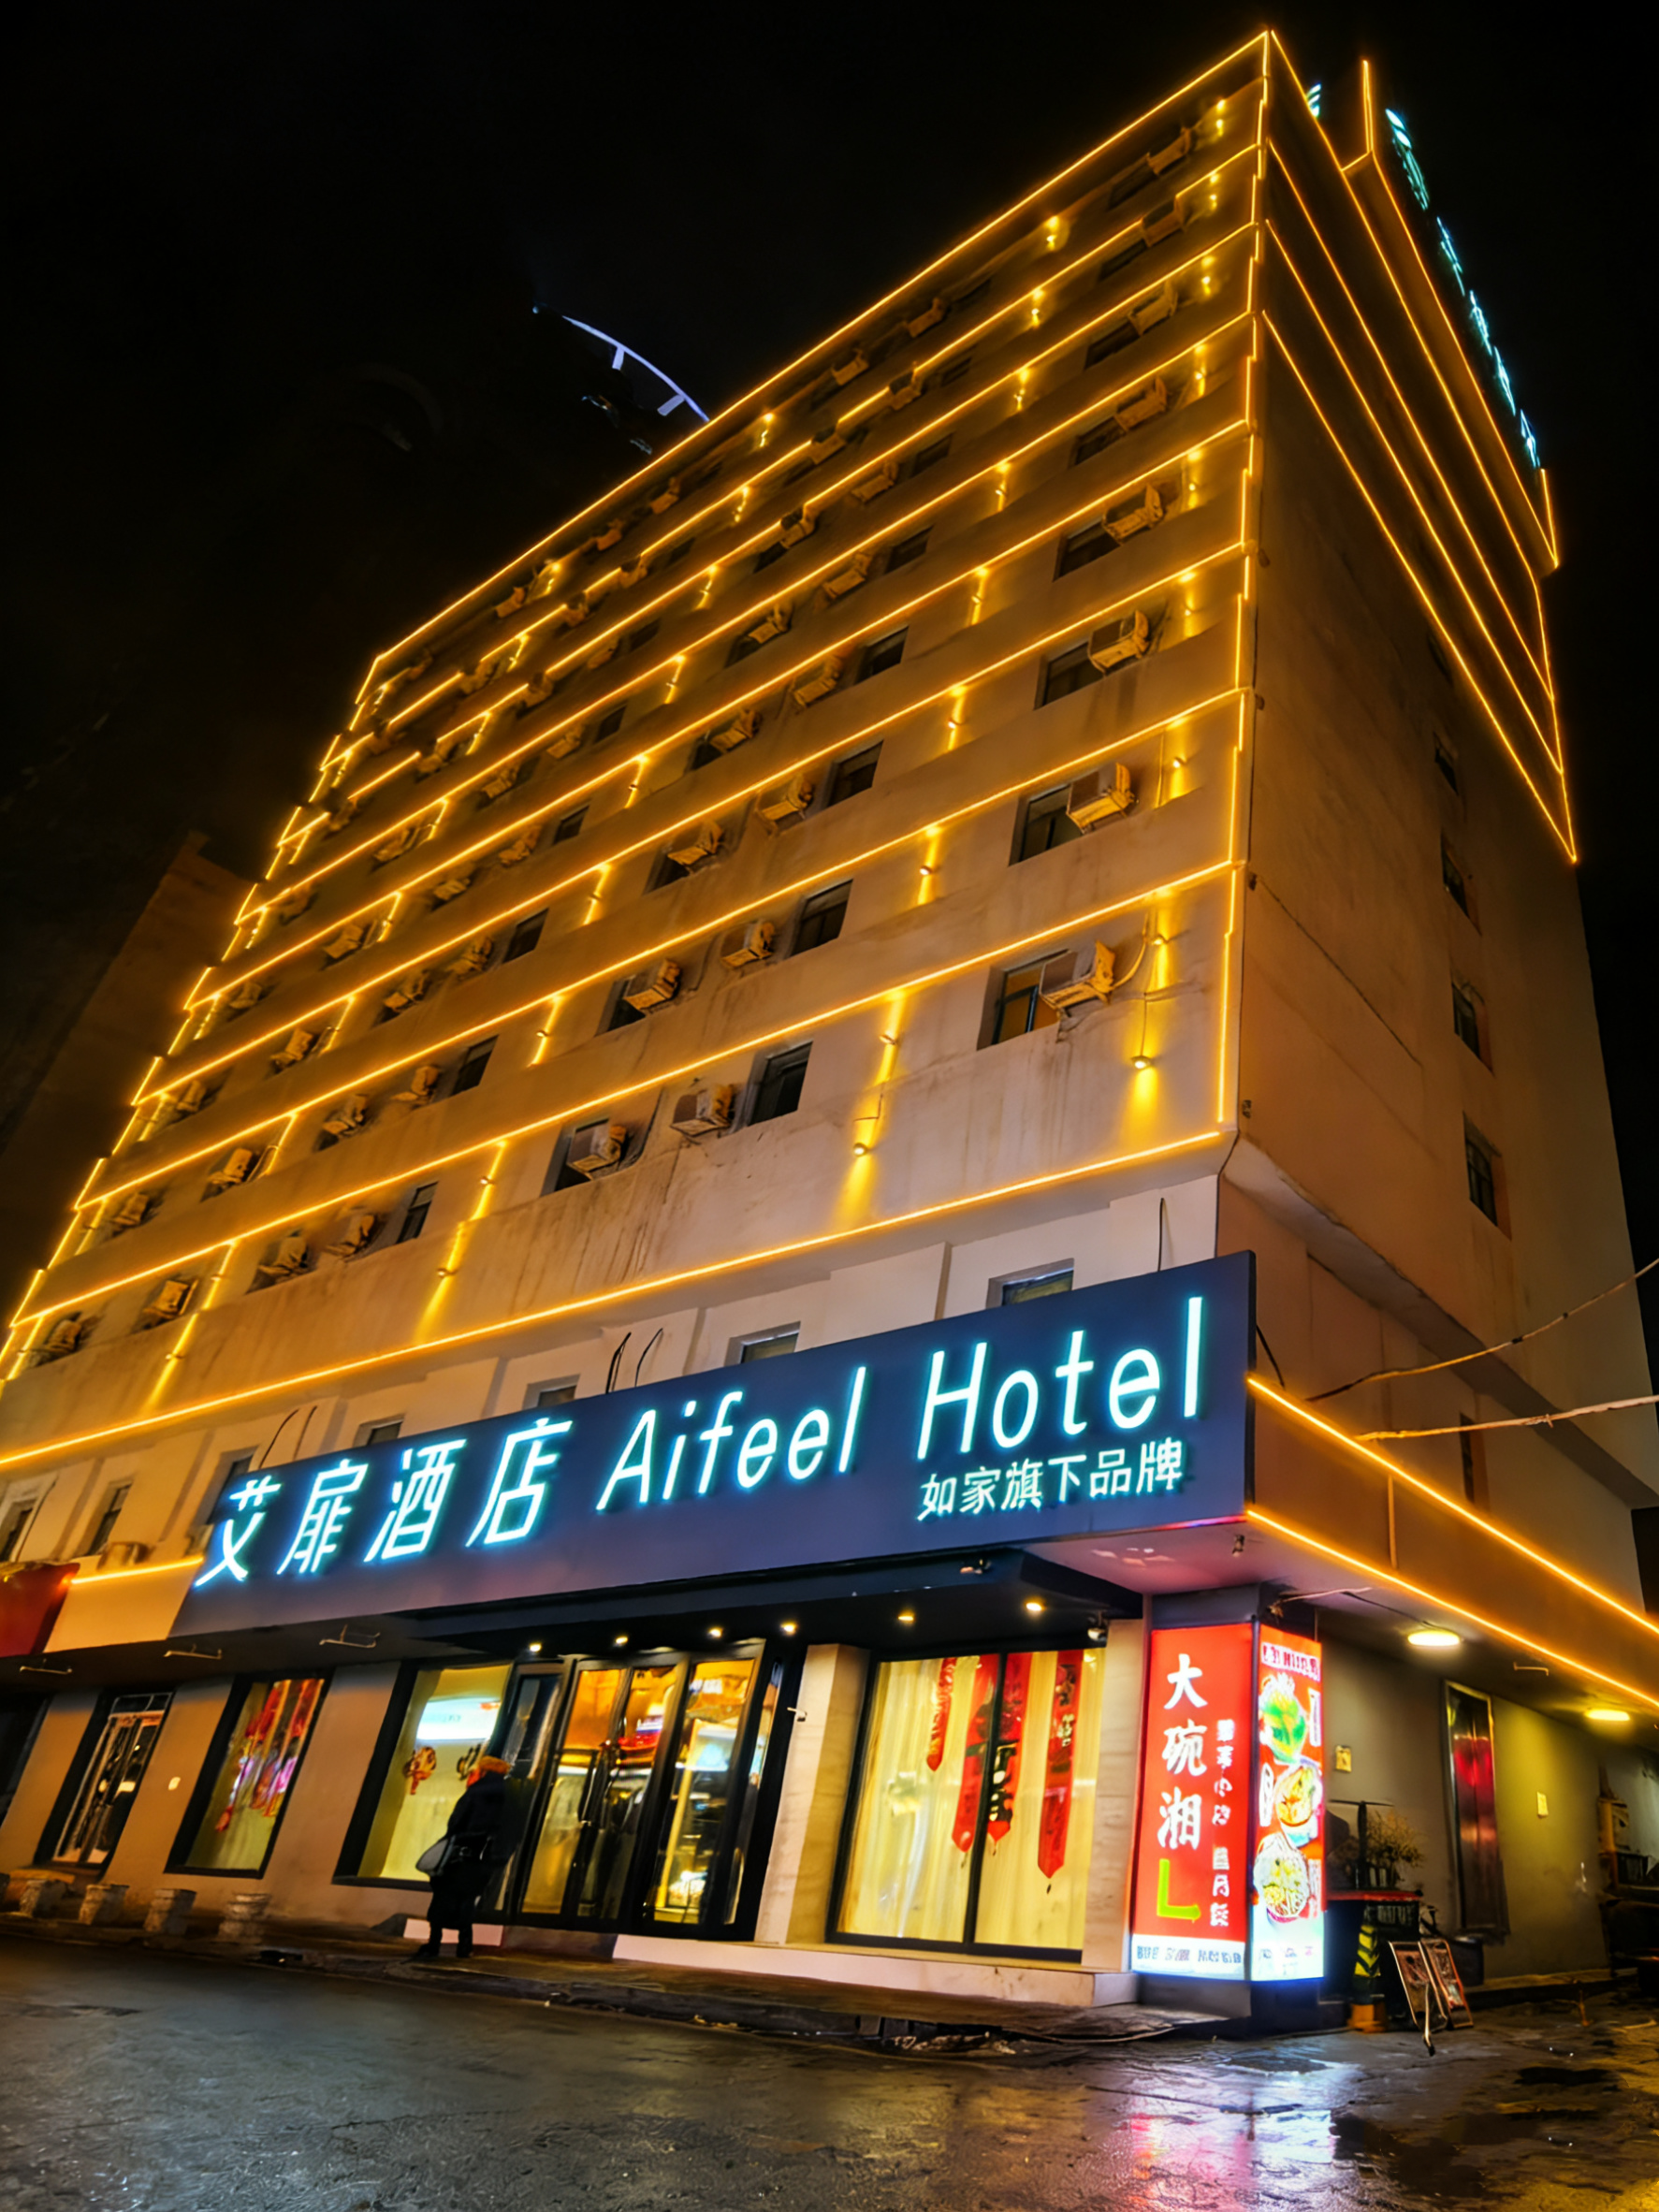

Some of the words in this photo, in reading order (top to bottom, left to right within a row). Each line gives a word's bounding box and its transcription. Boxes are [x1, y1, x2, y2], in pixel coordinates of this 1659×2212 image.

[595, 1366, 867, 1512] Aifeel
[916, 1296, 1203, 1461] Hotel
[916, 1436, 1185, 1521] 如家旗下品牌
[194, 1416, 573, 1589] 艾扉酒店
[1157, 1652, 1208, 1851] 大碗湘
